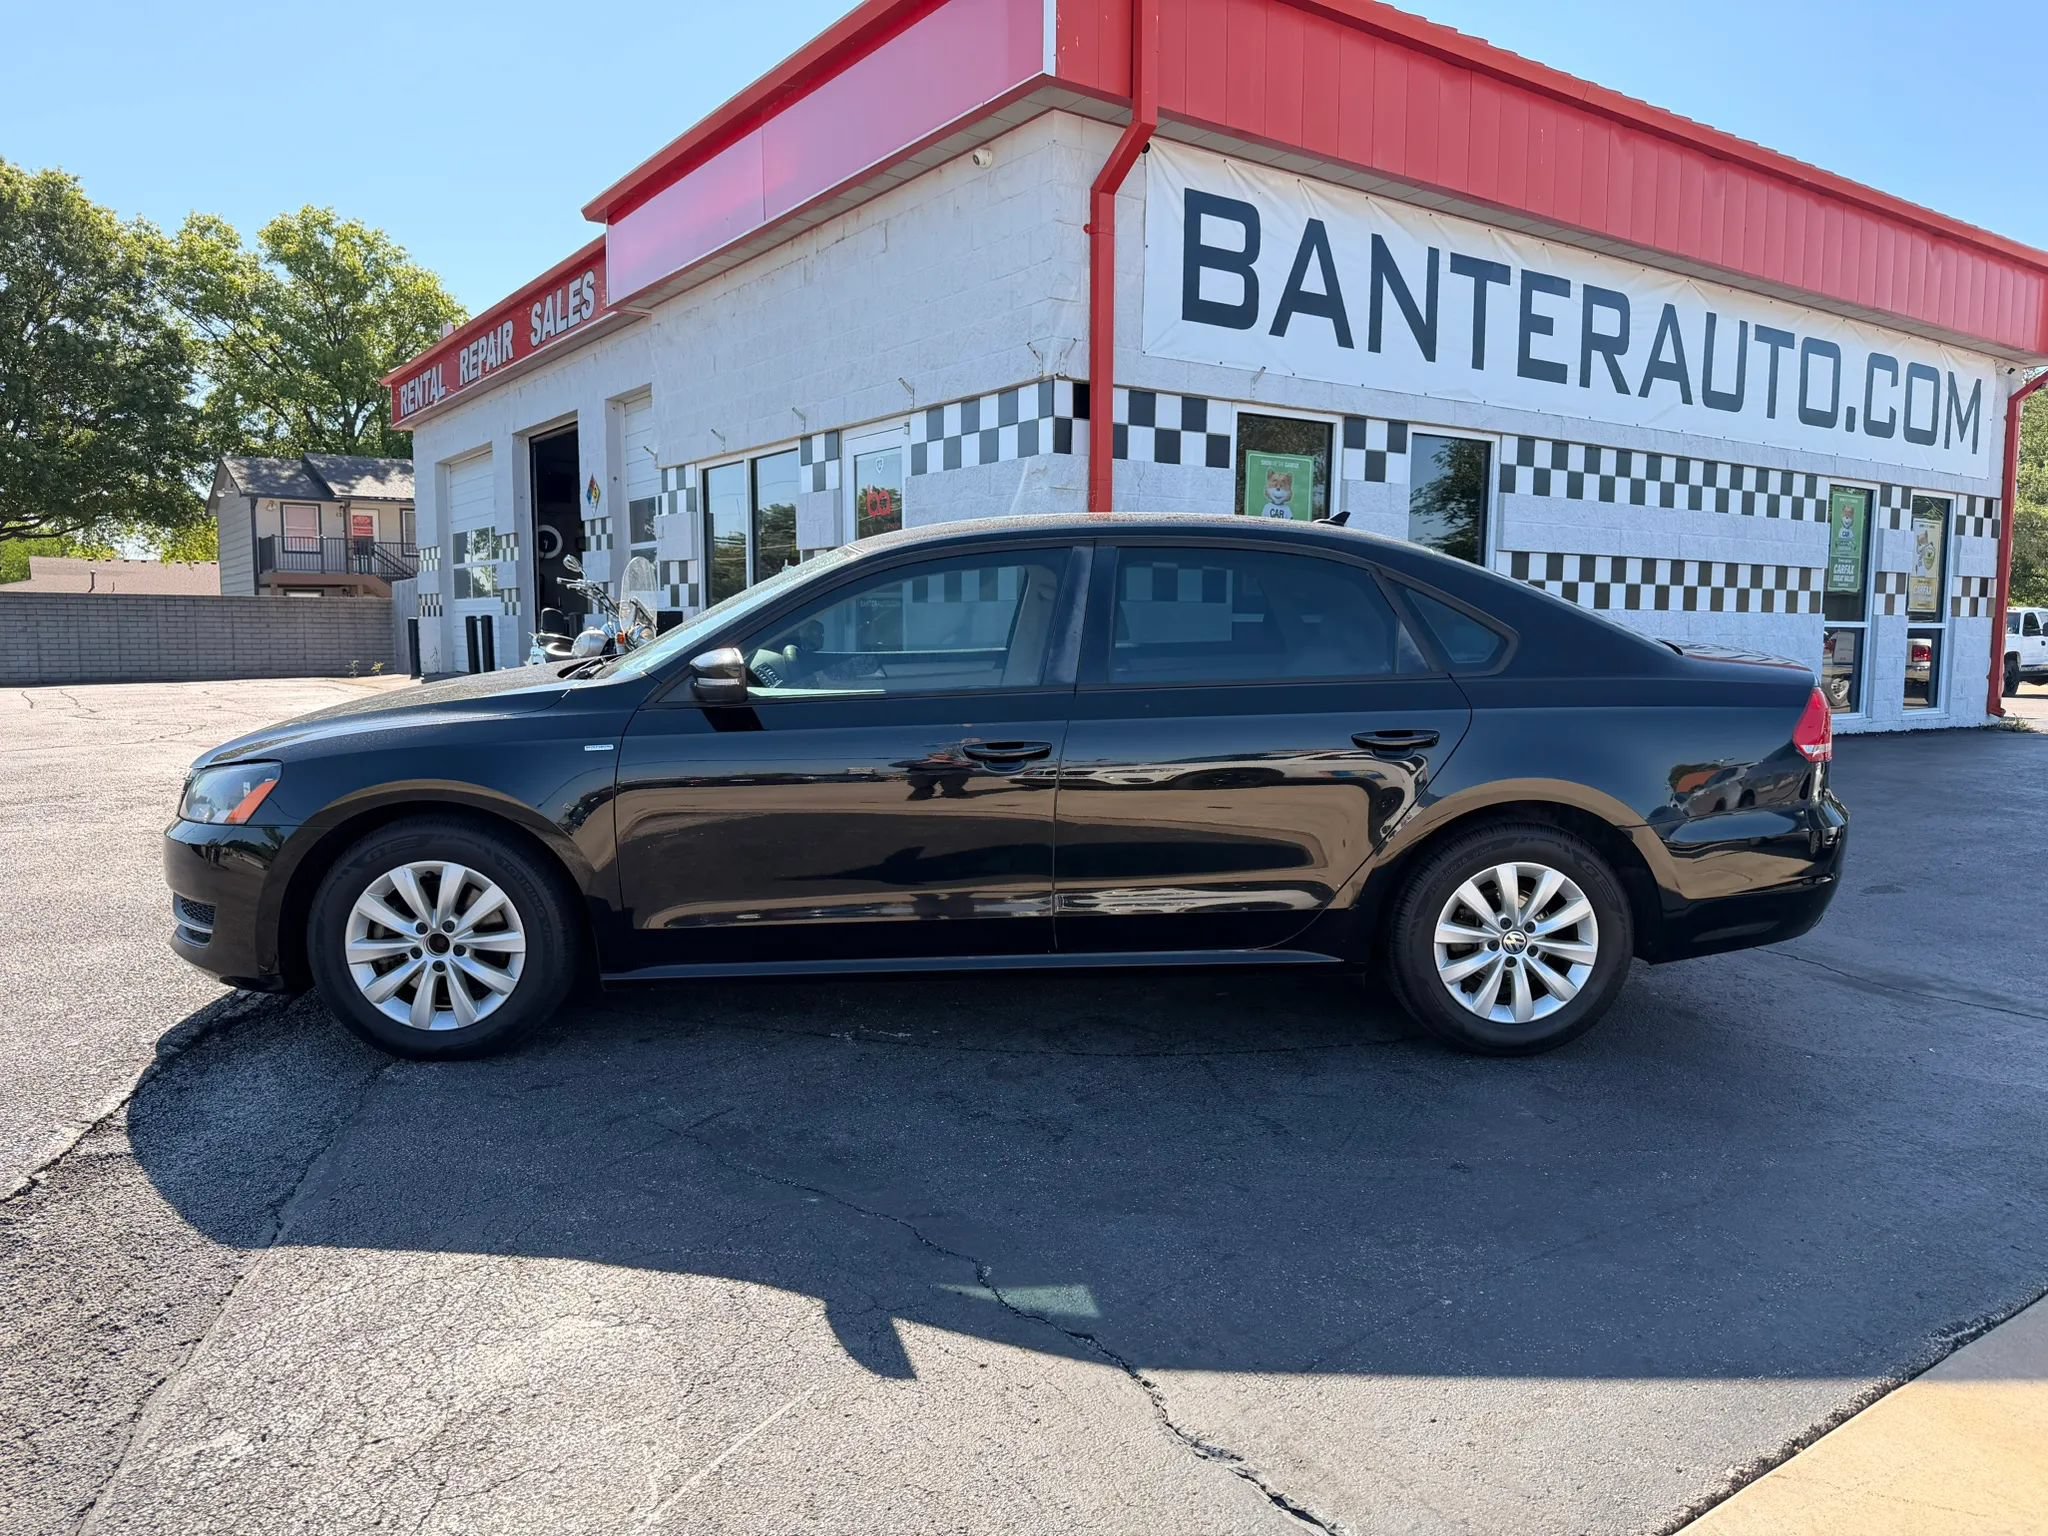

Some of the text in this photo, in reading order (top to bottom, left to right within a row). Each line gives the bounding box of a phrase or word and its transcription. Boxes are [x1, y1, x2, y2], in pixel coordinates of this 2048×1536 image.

[399, 270, 595, 418] RENTAL REPAIR SALES
[1181, 188, 1982, 455] BANTERAUTO.COM
